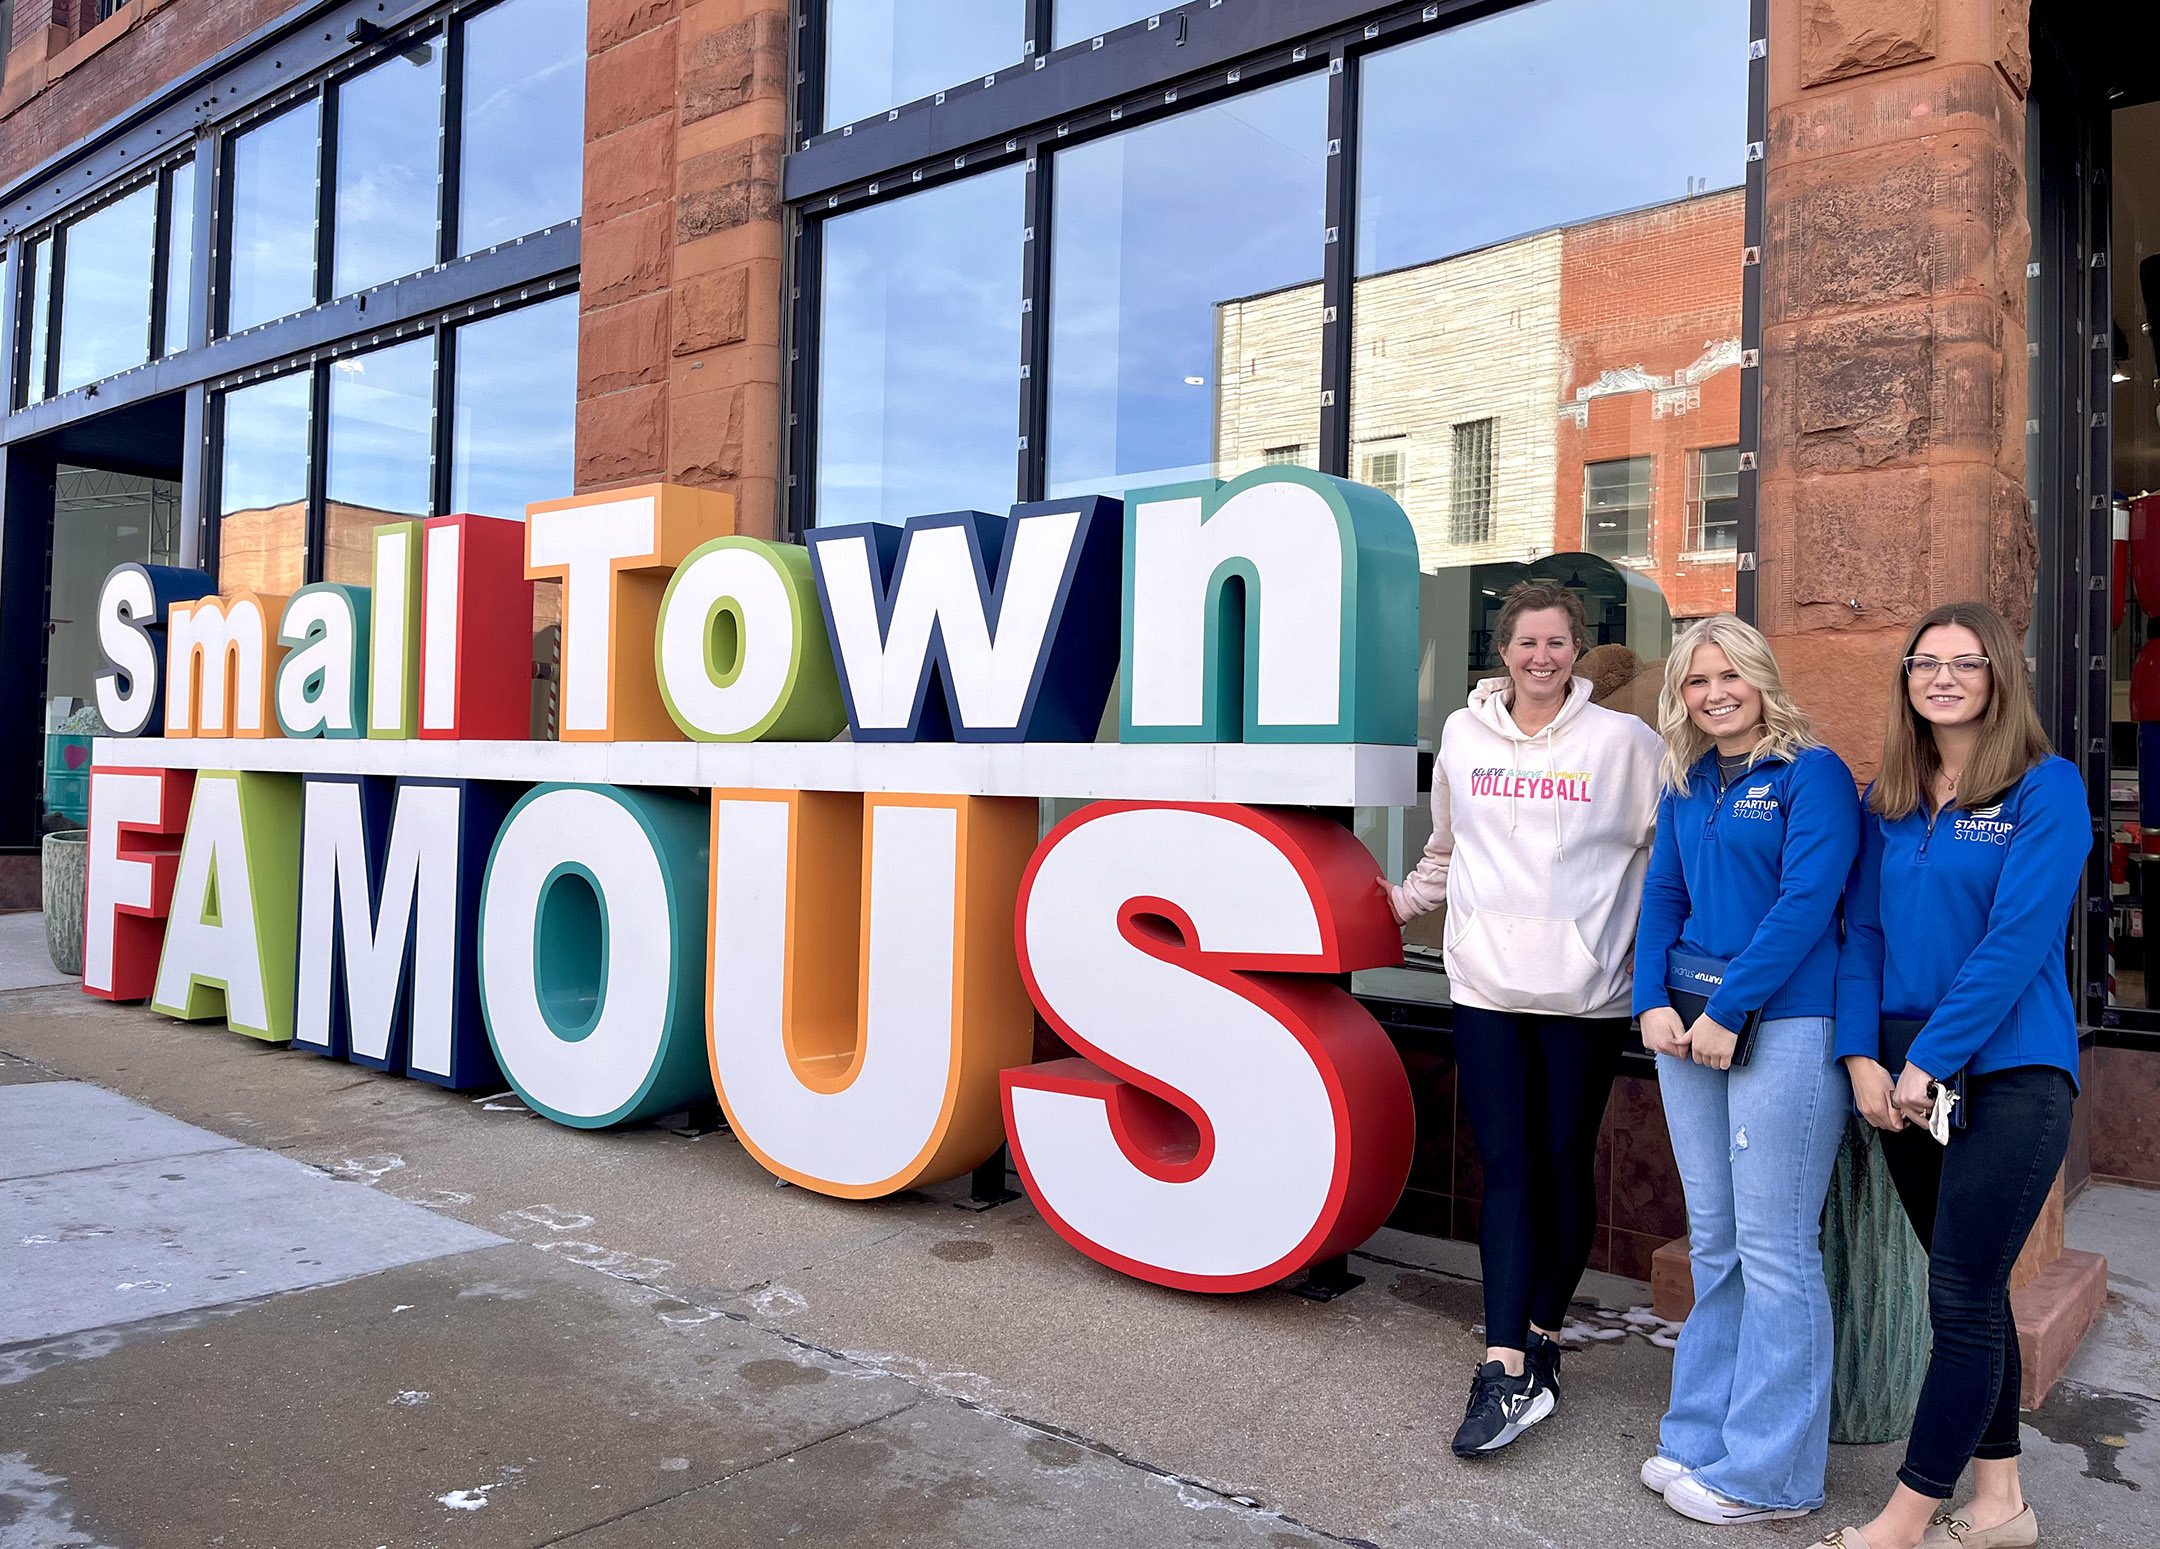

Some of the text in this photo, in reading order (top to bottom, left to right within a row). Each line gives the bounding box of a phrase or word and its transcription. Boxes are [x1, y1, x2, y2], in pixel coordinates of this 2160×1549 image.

[93, 465, 1360, 743] Small Town
[1471, 768, 1592, 782] BELIEVE AHIEVE DMINATE
[1471, 775, 1592, 802] VOLLEYBALL
[1733, 799, 1779, 811] STARTUP
[1732, 809, 1773, 822] STUDIO
[1954, 819, 2013, 834] STARTUP
[1954, 829, 2007, 846] STUDIO
[1671, 966, 1723, 985] TARTUP STUDIO
[82, 765, 1352, 1293] FAMOUS
